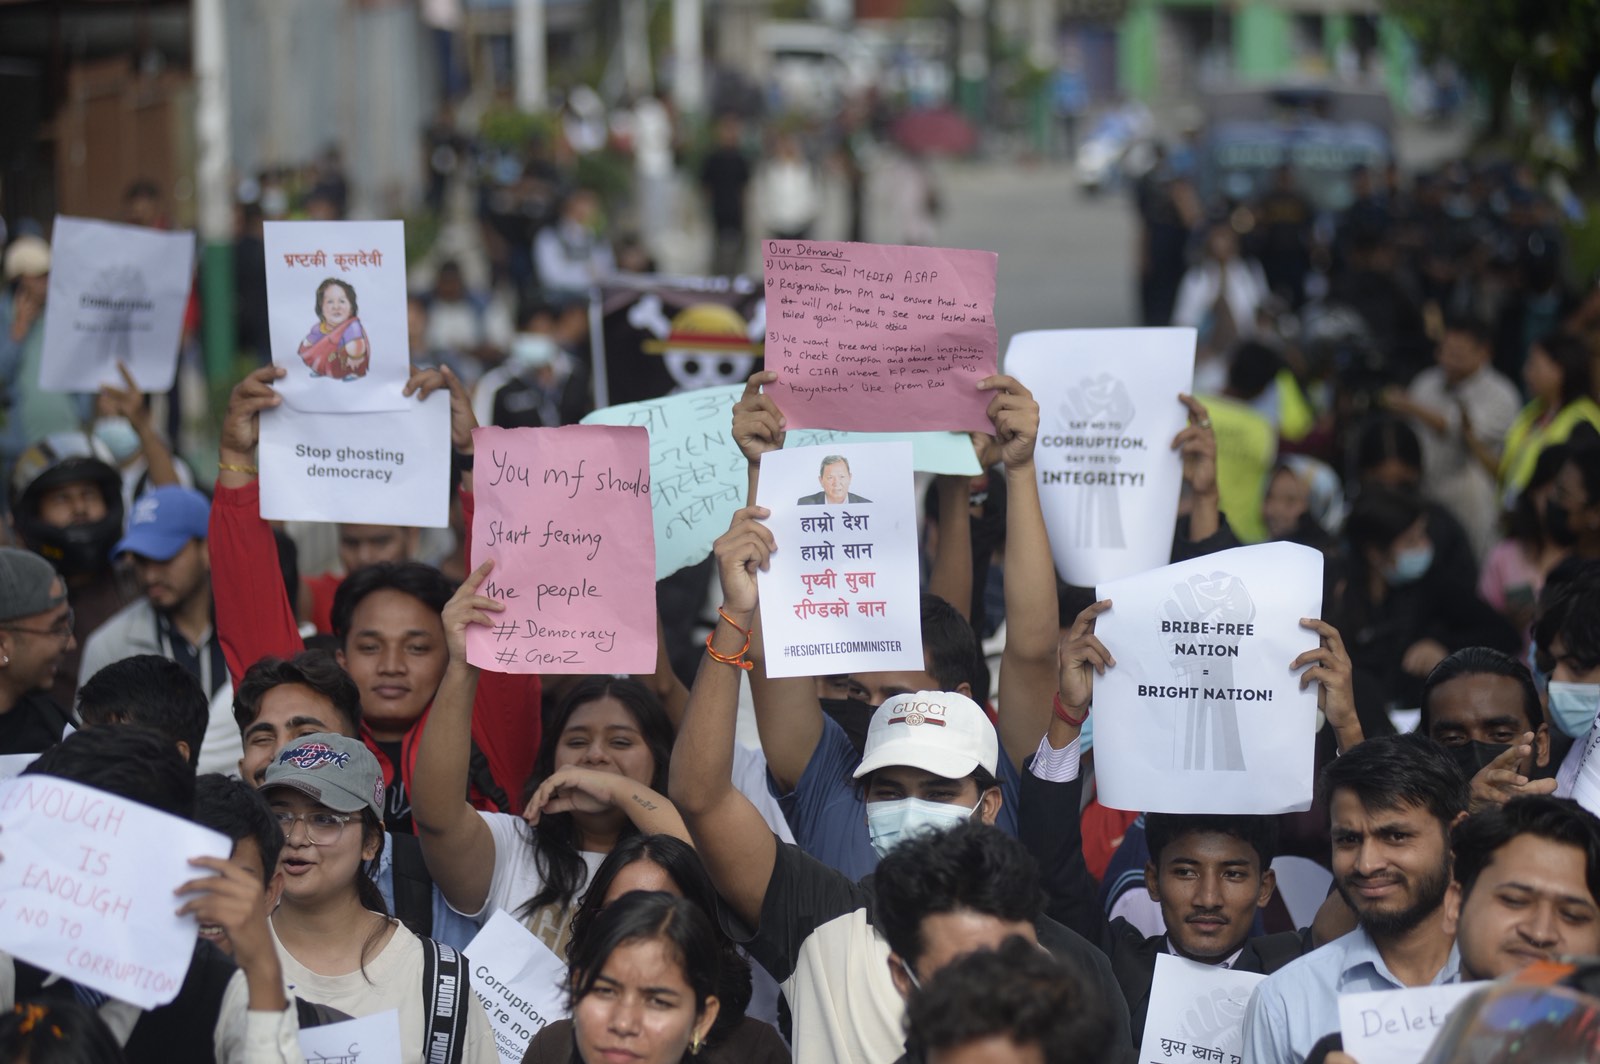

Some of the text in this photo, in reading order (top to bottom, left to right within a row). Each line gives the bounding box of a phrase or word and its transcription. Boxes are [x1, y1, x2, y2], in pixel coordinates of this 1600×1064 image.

[769, 242, 844, 258] Our Demands
[779, 260, 812, 272] Unban
[820, 263, 846, 277] Social
[904, 270, 938, 284] ASAP
[780, 278, 829, 295] Resignation
[858, 288, 874, 298] PM
[880, 293, 895, 301] and
[903, 295, 932, 305] ensure
[938, 296, 957, 307] that
[802, 297, 821, 309] will
[826, 302, 843, 311] not
[849, 304, 870, 314] have
[878, 306, 886, 316] to
[893, 310, 909, 319] see
[971, 315, 986, 323] and
[813, 314, 836, 328] again
[843, 315, 853, 324] in
[856, 320, 879, 330] public
[769, 331, 779, 342] 3)
[782, 334, 798, 344] We
[803, 338, 829, 347] want
[882, 344, 926, 355] impartial
[784, 347, 793, 358] to
[783, 364, 801, 375] not
[809, 367, 839, 377] CIAA
[847, 370, 880, 378] where
[889, 367, 906, 376] KP
[937, 364, 954, 374] put
[962, 364, 977, 373] his
[861, 382, 884, 393] like
[927, 379, 945, 389] Rai
[1041, 435, 1148, 451] CORRUPTION,
[296, 444, 404, 465] Stop ghosting
[307, 464, 393, 484] democracy
[490, 450, 650, 498] You mf should
[1042, 470, 1145, 487] INTEGRITY!
[800, 511, 869, 533] हाम्रो देश
[539, 520, 602, 561] fearing
[800, 541, 874, 561] हाम्रो सान
[801, 568, 876, 595] पृथ्वी सुबा
[486, 578, 603, 611] the people
[857, 601, 887, 618] बान
[1161, 620, 1255, 636] BRIBE-FREE
[783, 640, 902, 658] #RESIGNTELECOMMINISTER
[1174, 643, 1239, 657] NATION
[1138, 685, 1273, 702] BRIGHT NATION!
[892, 702, 948, 716] GUCCI
[78, 846, 112, 877] IS
[22, 863, 133, 922] ENOUGH
[16, 905, 83, 939] NO TO
[66, 946, 179, 993] CORRUPTION
[436, 974, 456, 1018] PUMA
[475, 965, 548, 1028] Corruption
[1360, 1005, 1446, 1038] Delet
[490, 1024, 525, 1056] ANSOCIA
[1160, 1038, 1187, 1057] घुस
[1192, 1045, 1225, 1064] खाने
[495, 1042, 525, 1064] ORRUP
